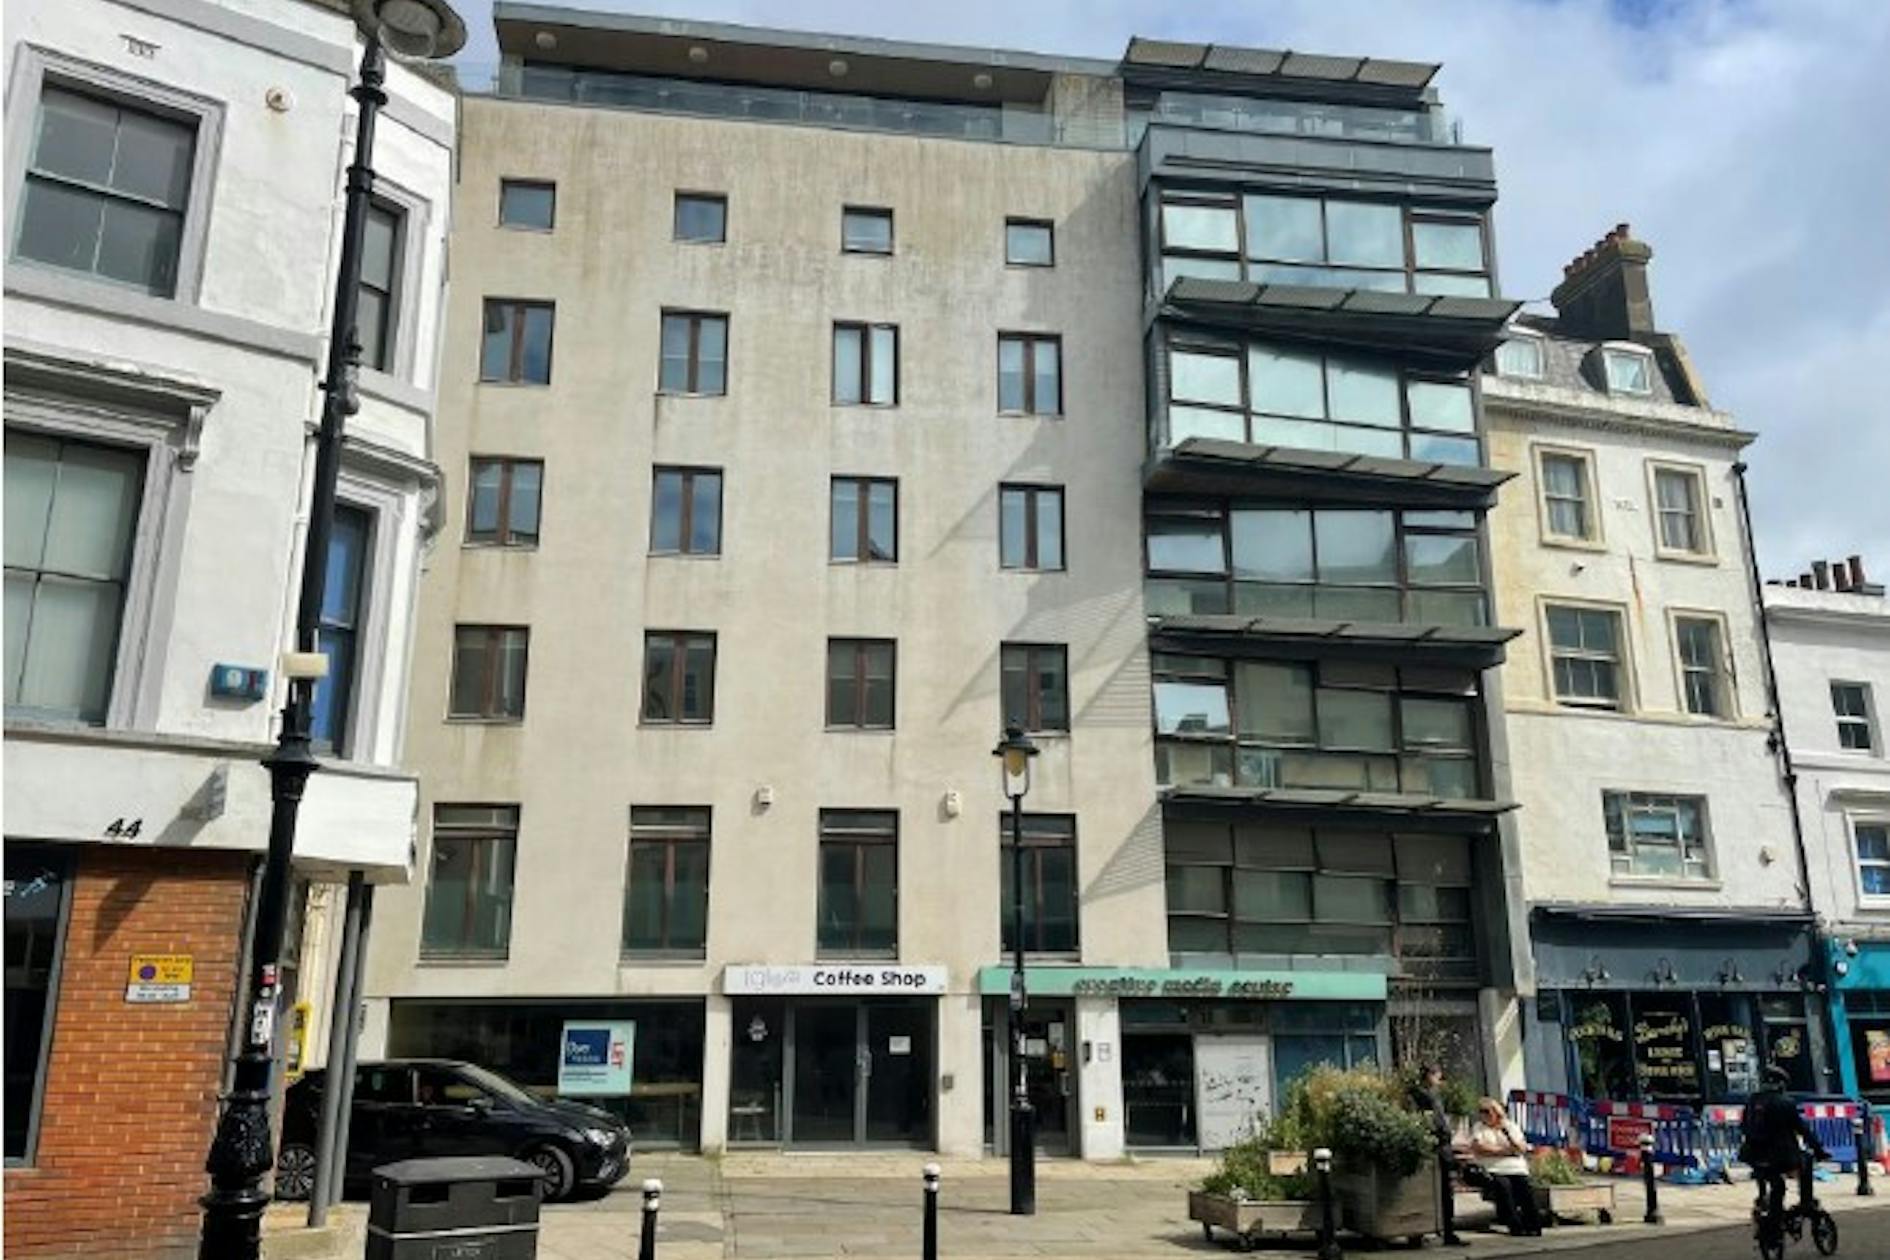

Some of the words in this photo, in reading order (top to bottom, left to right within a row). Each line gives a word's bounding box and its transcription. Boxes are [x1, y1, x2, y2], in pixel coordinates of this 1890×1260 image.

[104, 818, 142, 839] 44
[813, 971, 874, 986] Coffee
[881, 971, 926, 988] Shop
[1161, 977, 1223, 994] media
